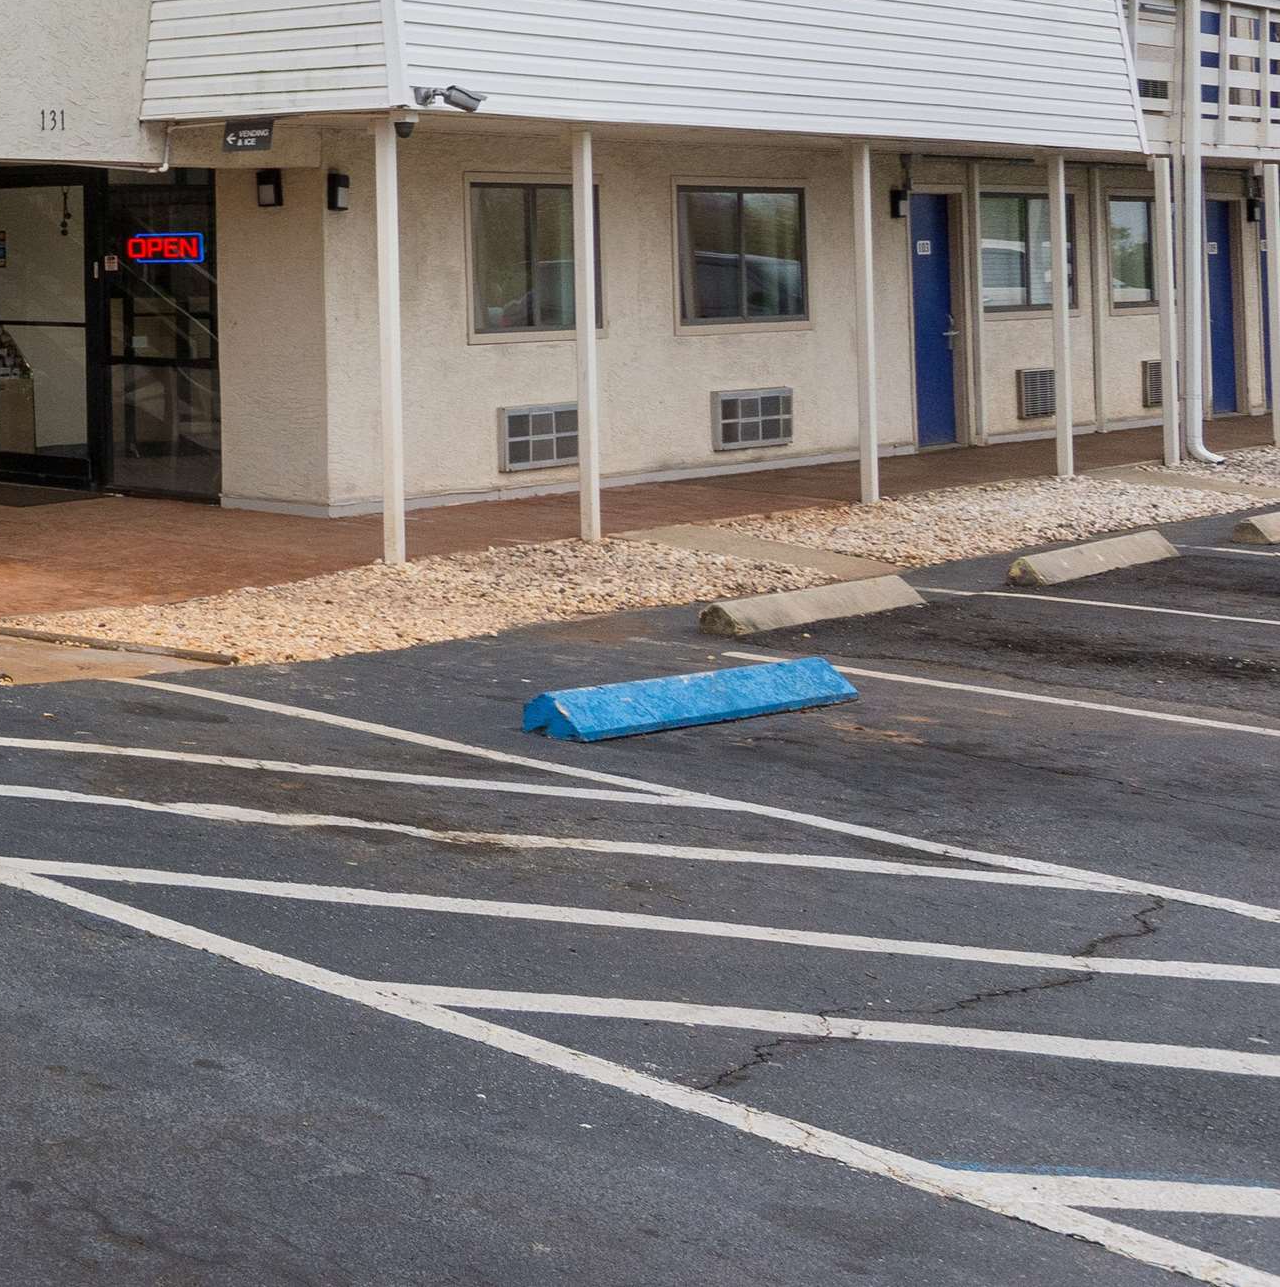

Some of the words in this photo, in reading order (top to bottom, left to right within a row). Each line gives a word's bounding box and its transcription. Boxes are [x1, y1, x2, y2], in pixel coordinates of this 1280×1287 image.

[40, 109, 66, 131] 131
[239, 128, 269, 138] VENDING
[244, 137, 257, 146] ICE
[128, 237, 199, 259] OPEN
